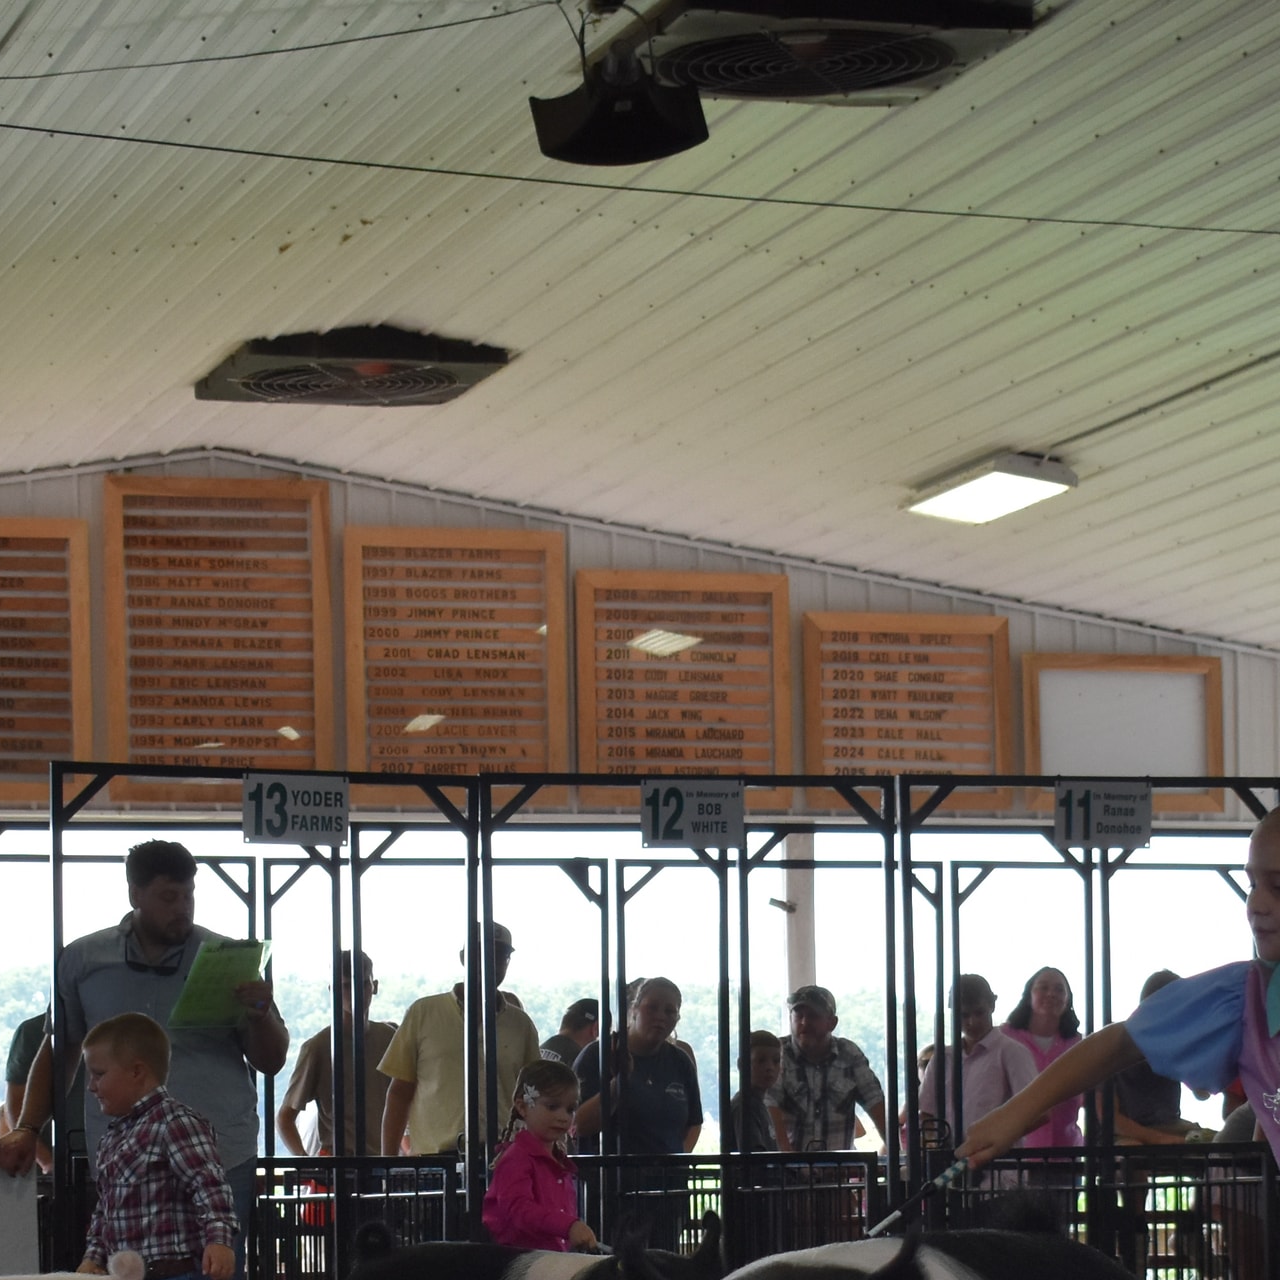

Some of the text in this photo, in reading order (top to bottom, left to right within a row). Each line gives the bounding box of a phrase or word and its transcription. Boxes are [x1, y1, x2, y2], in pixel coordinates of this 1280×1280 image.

[405, 550, 501, 560] BLAZER FARMS
[128, 556, 268, 570] 1985 MARK SOMMERS
[367, 567, 502, 580] 1997 BLAZER FARMS
[168, 577, 201, 587] MATT
[212, 579, 250, 590] WHITE
[367, 588, 517, 600] 1998 BOGGS BROTHERS
[130, 595, 276, 609] 1987 RANAE DONOHOE
[368, 608, 496, 620] 1999 JIMMY PRINCE
[606, 610, 637, 620] 2009
[172, 617, 211, 628] MINDY
[370, 628, 500, 639] 2000 JIMMY PRINCE
[607, 630, 634, 639] 2010
[832, 632, 910, 643] 2018 VICTORIA
[173, 637, 223, 648] TAMARA
[233, 638, 282, 649] BLAZER
[384, 648, 526, 659] 2001 CHAD LENSMAN
[606, 649, 630, 659] 2011
[214, 658, 273, 670] LENSMAN
[374, 668, 508, 679] 2002 LISA KNOX
[606, 670, 724, 681] 2012 CODY LENSMAN
[833, 670, 944, 682] 2020 SHAE CONRAD
[132, 676, 266, 689] 1991 ERIC LENSMAN
[422, 688, 525, 697] CODY LENSMAN
[607, 689, 728, 702] 2013 MAGGIE GRIESER
[832, 689, 954, 702] 2021 WYATT FAULKNER
[132, 696, 272, 708] 1992 AMANDA LEWIS
[607, 708, 702, 721] 2014 JACK WING
[833, 708, 942, 720] 2022 WILSON
[133, 715, 264, 727] 1993 CARLY CLARK
[436, 726, 469, 736] LACIE
[607, 727, 744, 740] 2015 MIRANDA LAUCHARD
[833, 728, 943, 740] 2023 CALE HALL
[133, 735, 165, 746] 1994
[231, 737, 280, 748] PROPST
[424, 746, 507, 755] JOEY BROWN
[608, 747, 743, 759] 2016 MIRANDA LAUCHARD
[833, 747, 941, 760] 2024 CALE HALL
[174, 756, 256, 767] EMILY PRICE
[381, 763, 516, 773] 2007 GARRETT DALLAS
[608, 766, 636, 774] 2017
[291, 790, 344, 808] YODER
[696, 791, 729, 800] Memory
[1104, 793, 1137, 802] Memory
[1139, 793, 1148, 801] of
[248, 782, 288, 837] 13
[645, 787, 684, 840] 12
[697, 803, 722, 815] BOB
[1059, 789, 1091, 840] 11
[1104, 805, 1136, 817] Ranae
[291, 814, 343, 832] FARMS
[691, 821, 728, 833] WHITE
[1096, 822, 1142, 834] Donohoe
